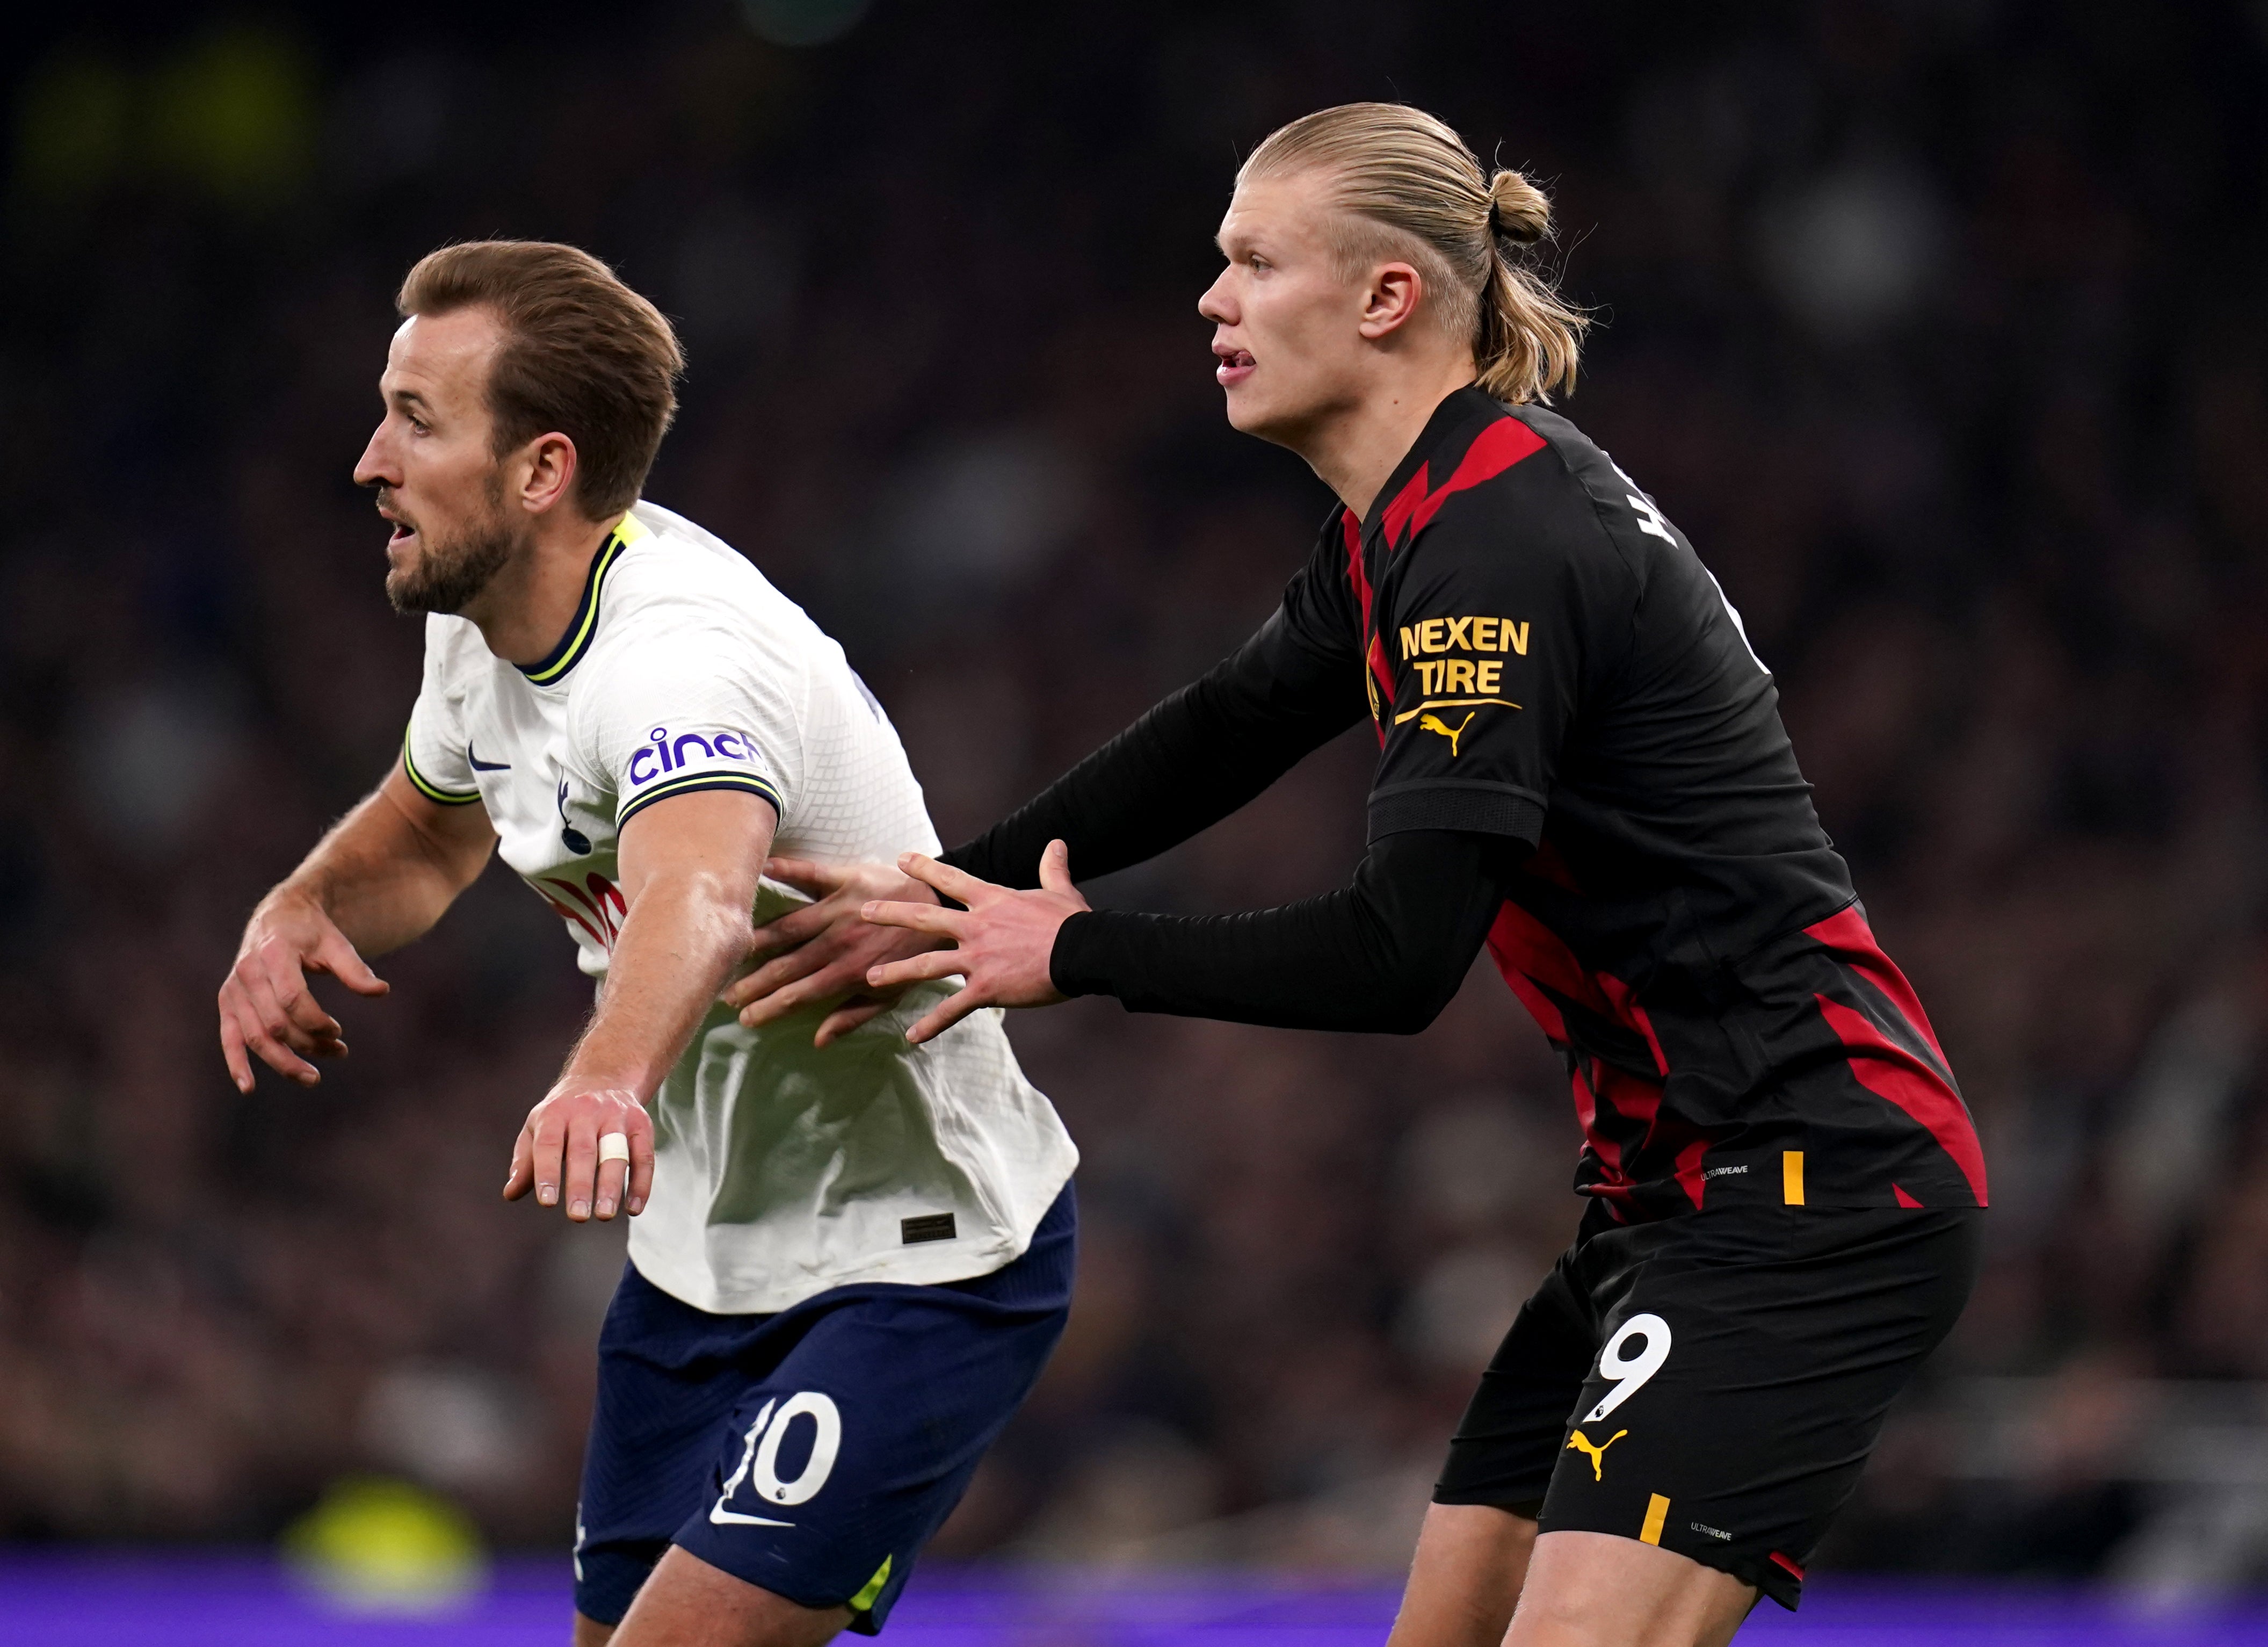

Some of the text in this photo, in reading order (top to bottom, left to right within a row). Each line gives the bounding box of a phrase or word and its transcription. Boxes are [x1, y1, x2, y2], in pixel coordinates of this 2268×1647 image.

[1400, 616, 1530, 661] NEXEN
[1413, 658, 1504, 696] TIRE
[1700, 1165, 1748, 1182] ULTRAWEAVE
[1580, 1312, 1672, 1424] 9
[722, 1391, 842, 1506] 10
[1690, 1521, 1732, 1541] ULTRAWEAVE
